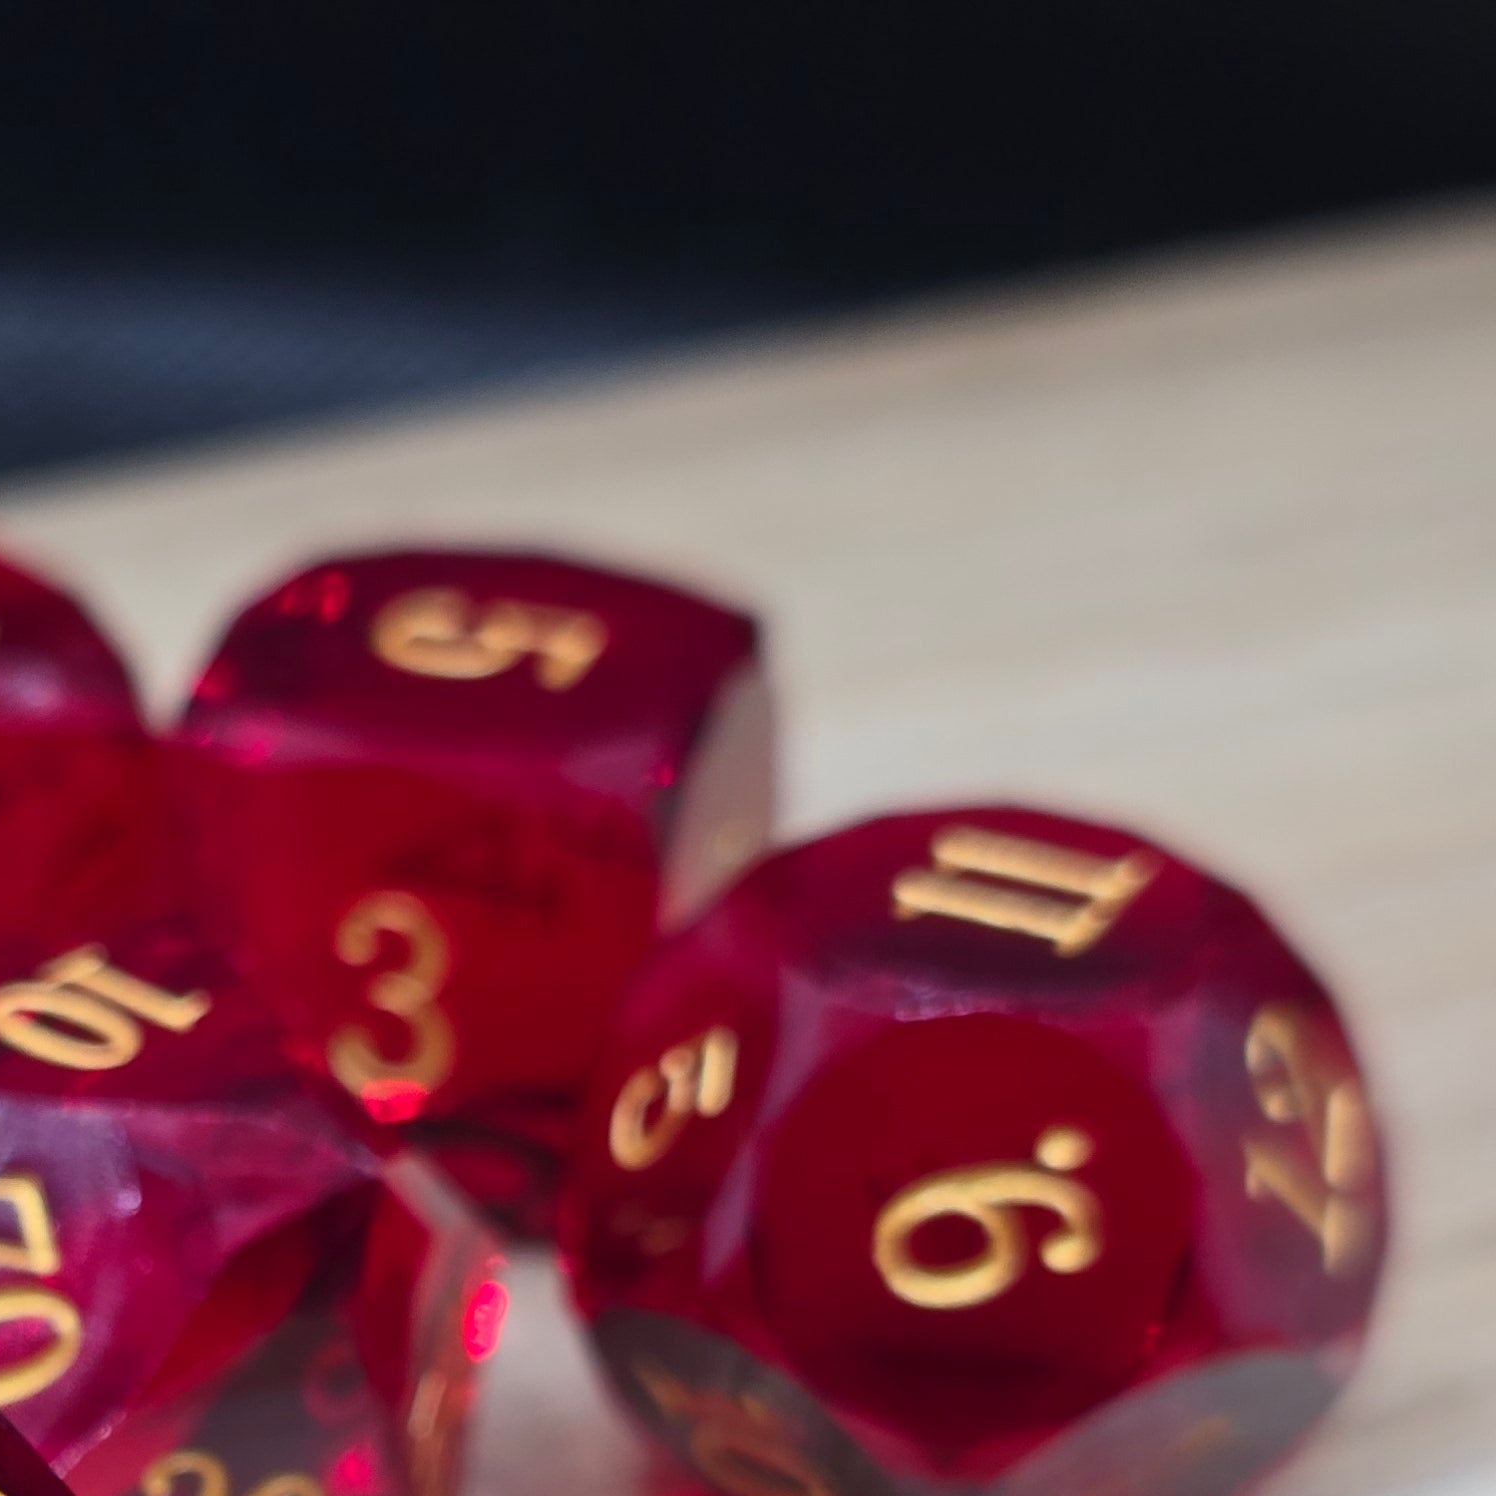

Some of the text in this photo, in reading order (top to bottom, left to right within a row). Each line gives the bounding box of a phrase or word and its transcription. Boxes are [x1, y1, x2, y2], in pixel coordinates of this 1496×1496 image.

[370, 585, 609, 691] 5
[893, 823, 1160, 954] 11
[326, 890, 455, 1106] 3
